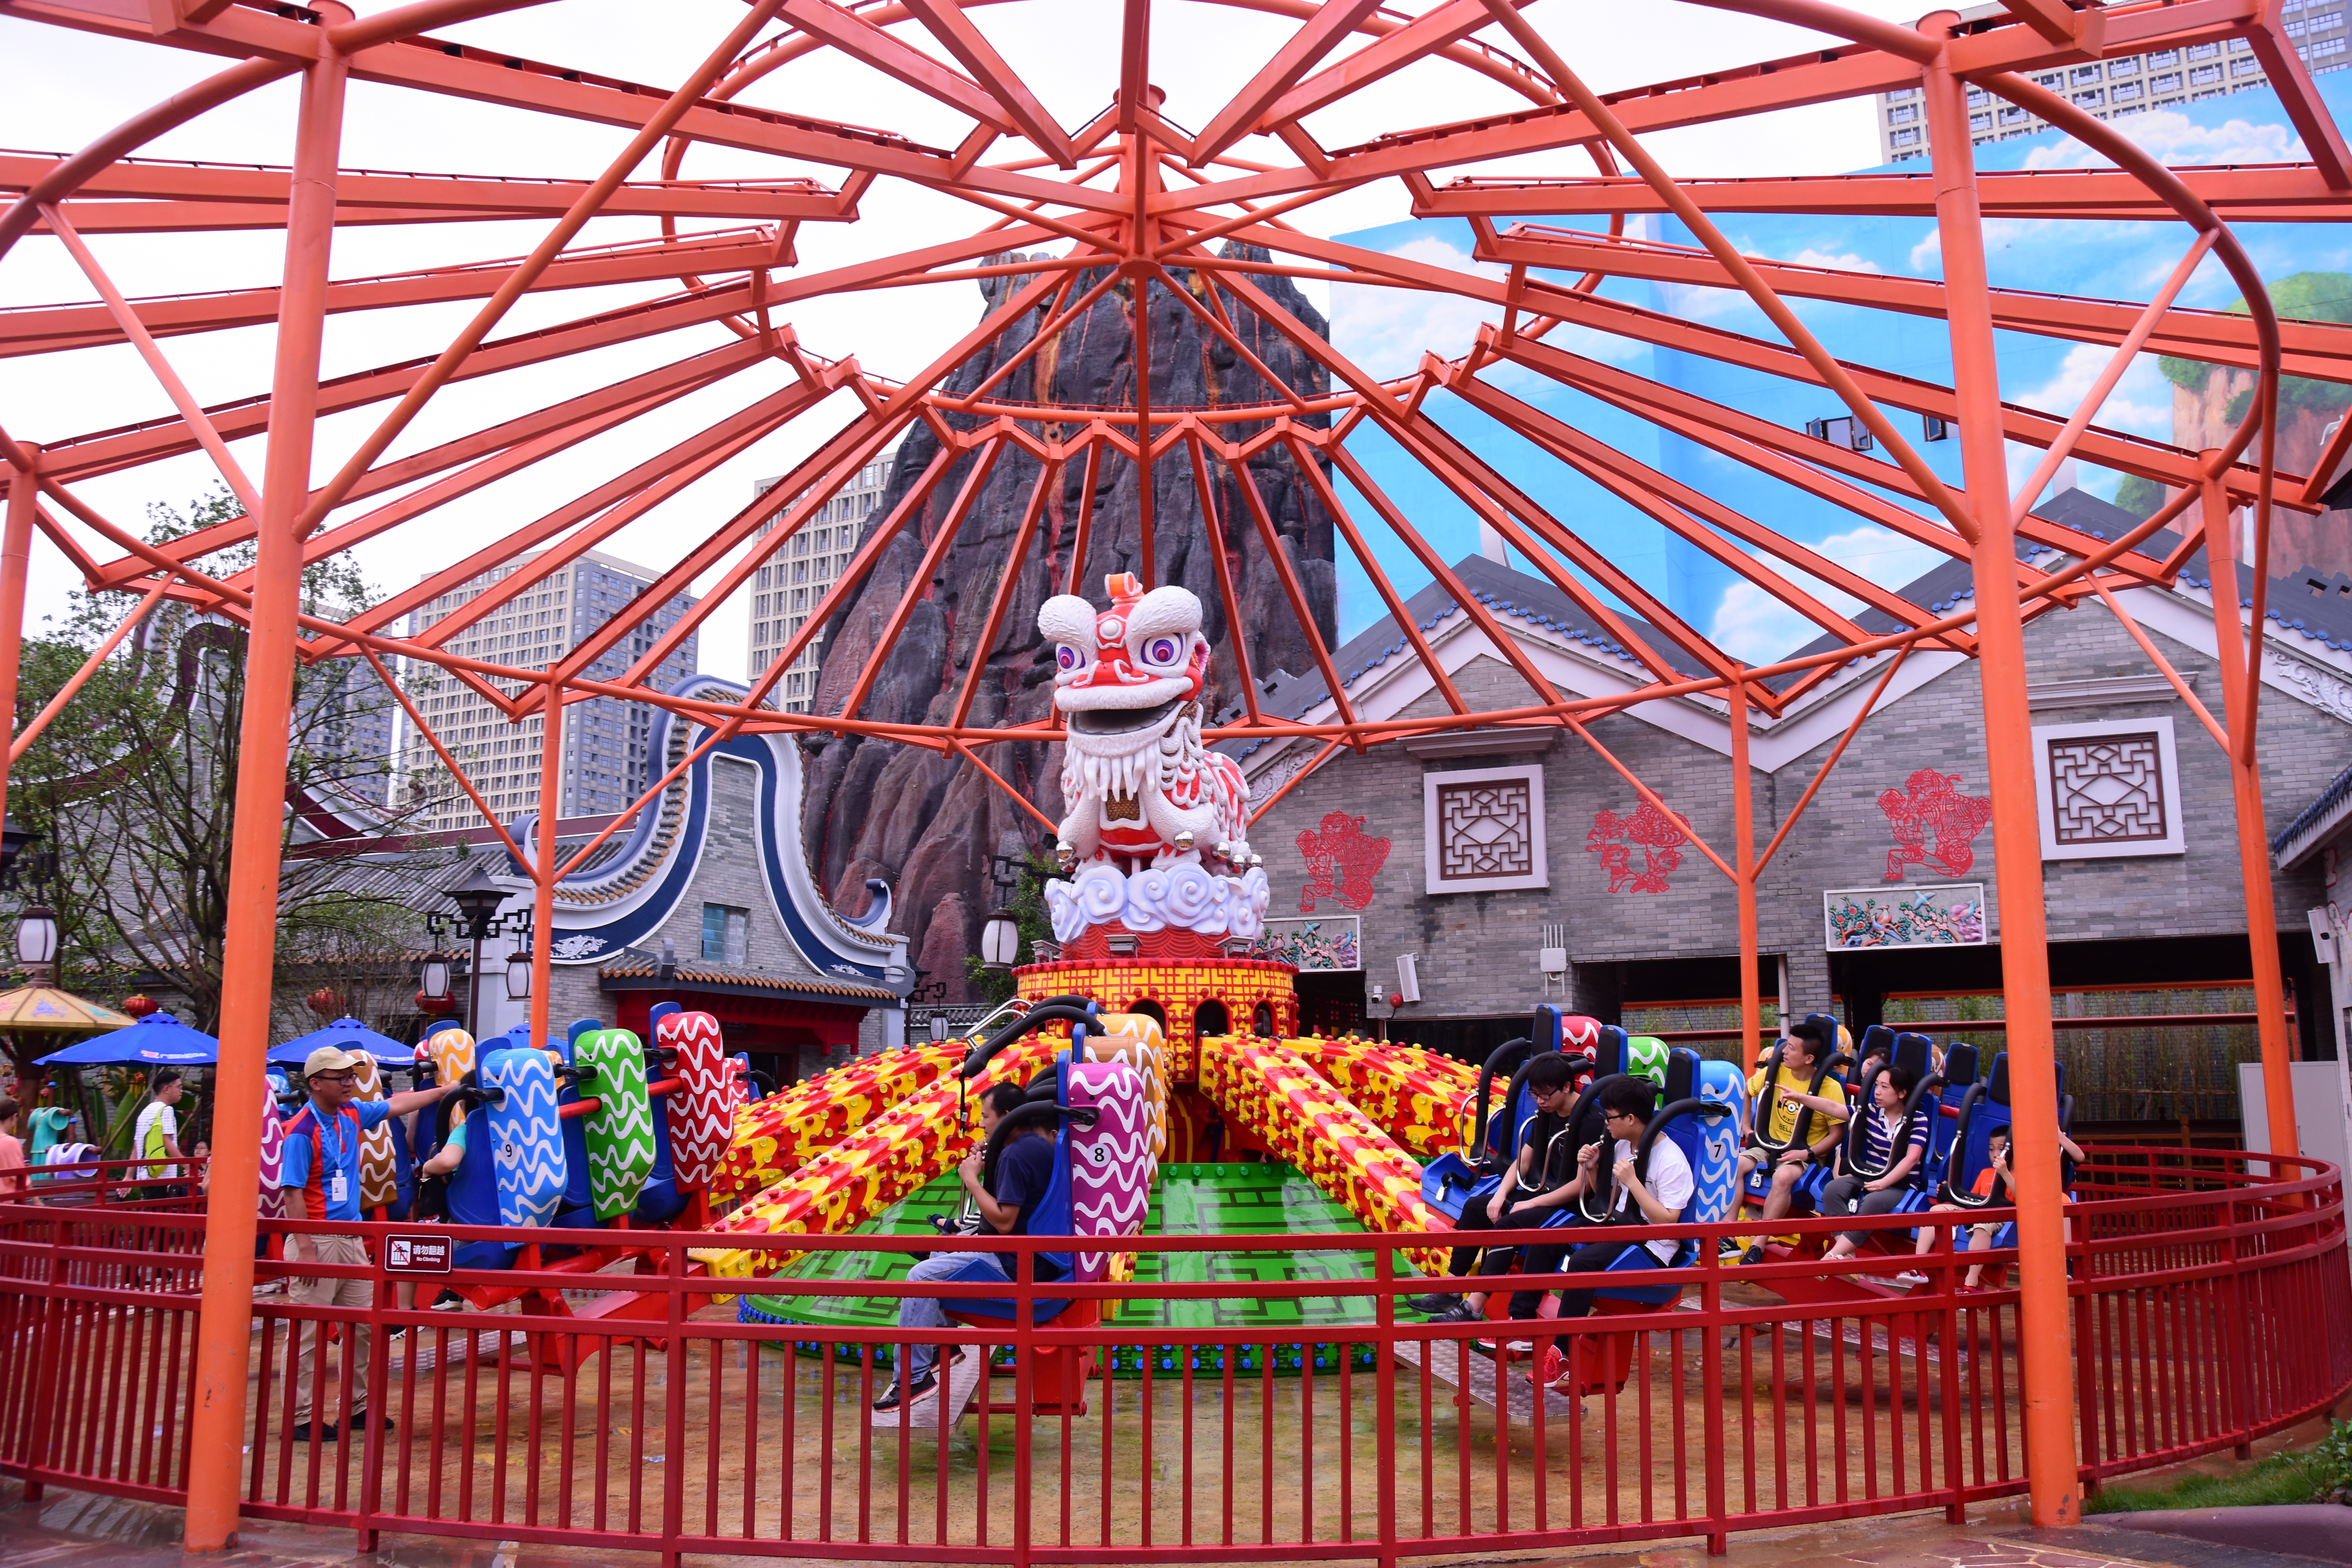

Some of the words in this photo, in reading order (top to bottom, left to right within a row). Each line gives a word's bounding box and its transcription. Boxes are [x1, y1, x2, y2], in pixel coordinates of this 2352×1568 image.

[1779, 1124, 1792, 1133] BELL
[505, 1144, 512, 1158] 9
[1094, 1147, 1105, 1162] 8
[1714, 1144, 1722, 1158] 7
[413, 1245, 445, 1255] 请勿翻越
